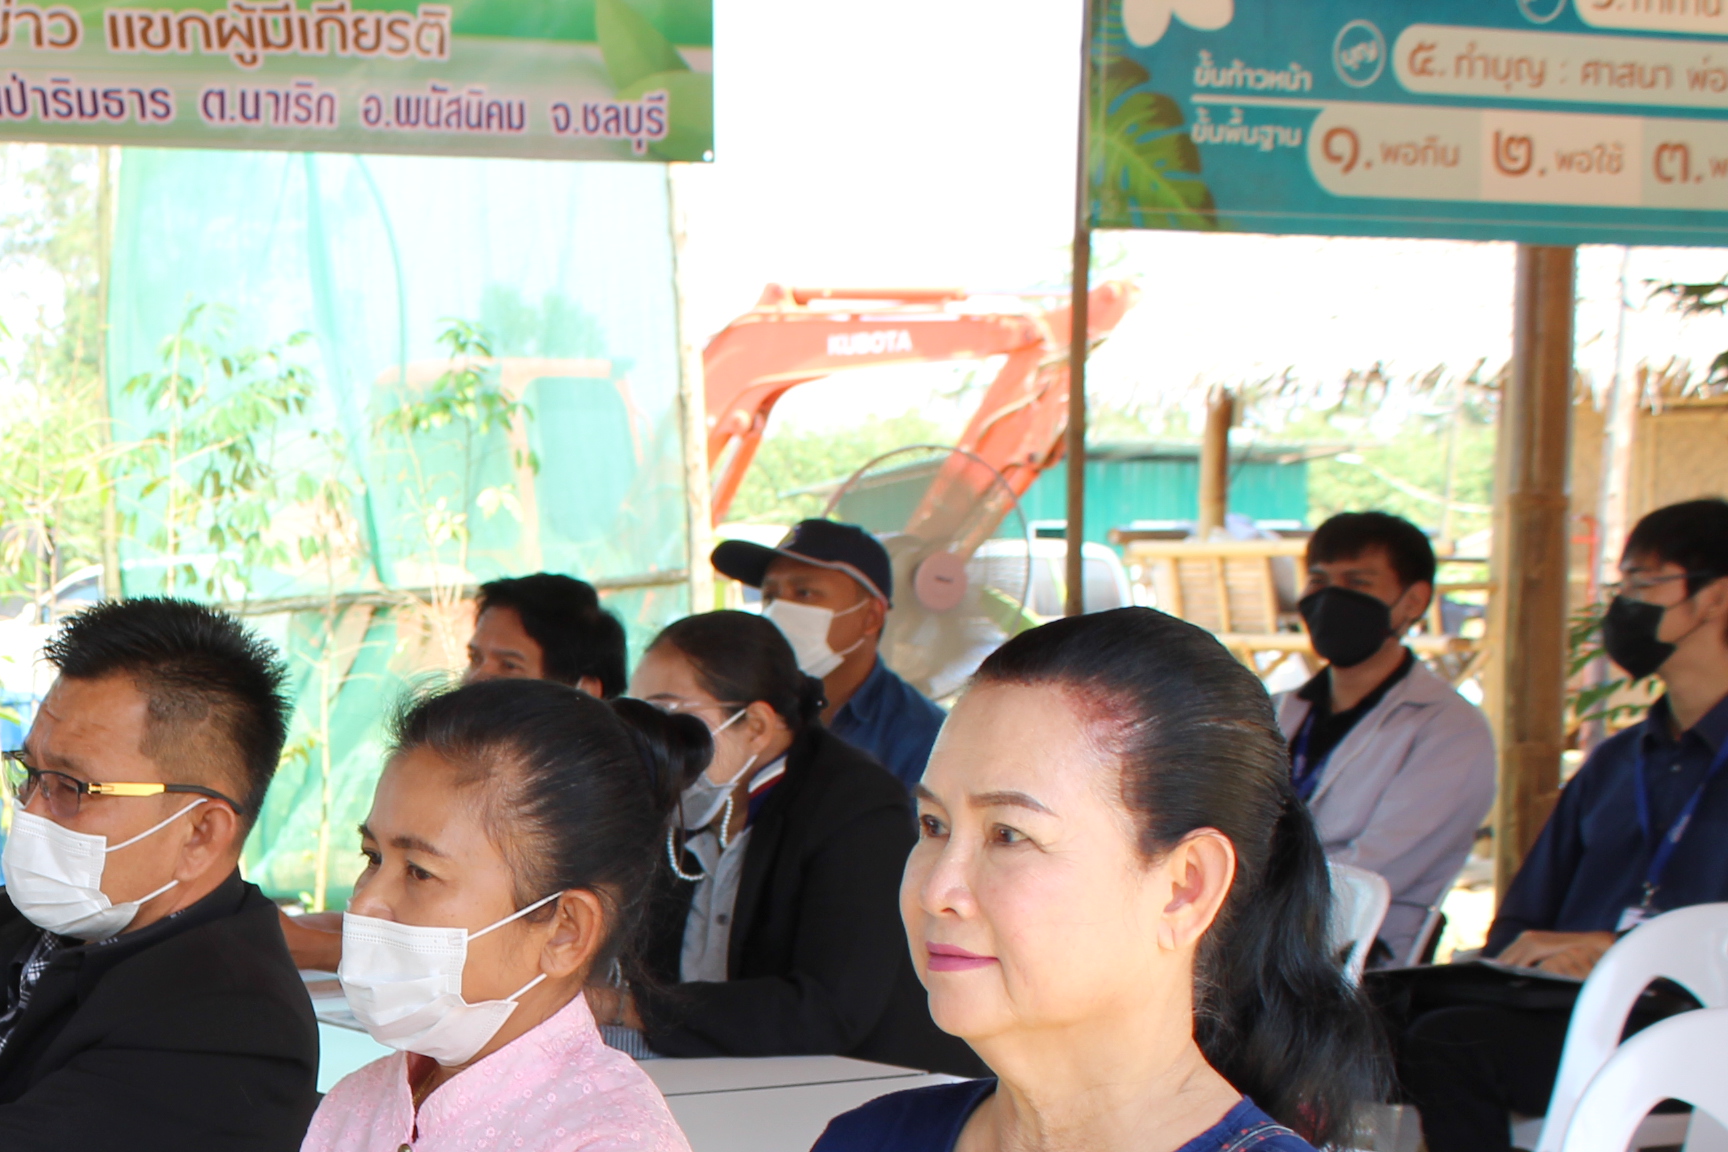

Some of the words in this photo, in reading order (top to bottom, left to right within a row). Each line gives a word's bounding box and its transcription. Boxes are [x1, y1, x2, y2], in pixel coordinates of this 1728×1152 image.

[109, 2, 447, 66] แขกผู้มีเกียรติ
[1194, 49, 1313, 92] ขั้นก้าวหน้า
[1454, 41, 1546, 92] ทำบุญ
[1580, 59, 1671, 91] ศาสนา
[203, 82, 335, 125] ต.นาเริก
[363, 84, 524, 131] อ.พนัสนิคม
[551, 95, 665, 150] จ.ชลบุรี
[1191, 107, 1302, 151] ขั้นพื้นฐาน
[1379, 134, 1460, 168] พอกิน
[1555, 141, 1623, 175] พอใช้
[827, 329, 913, 356] KUBOTA
